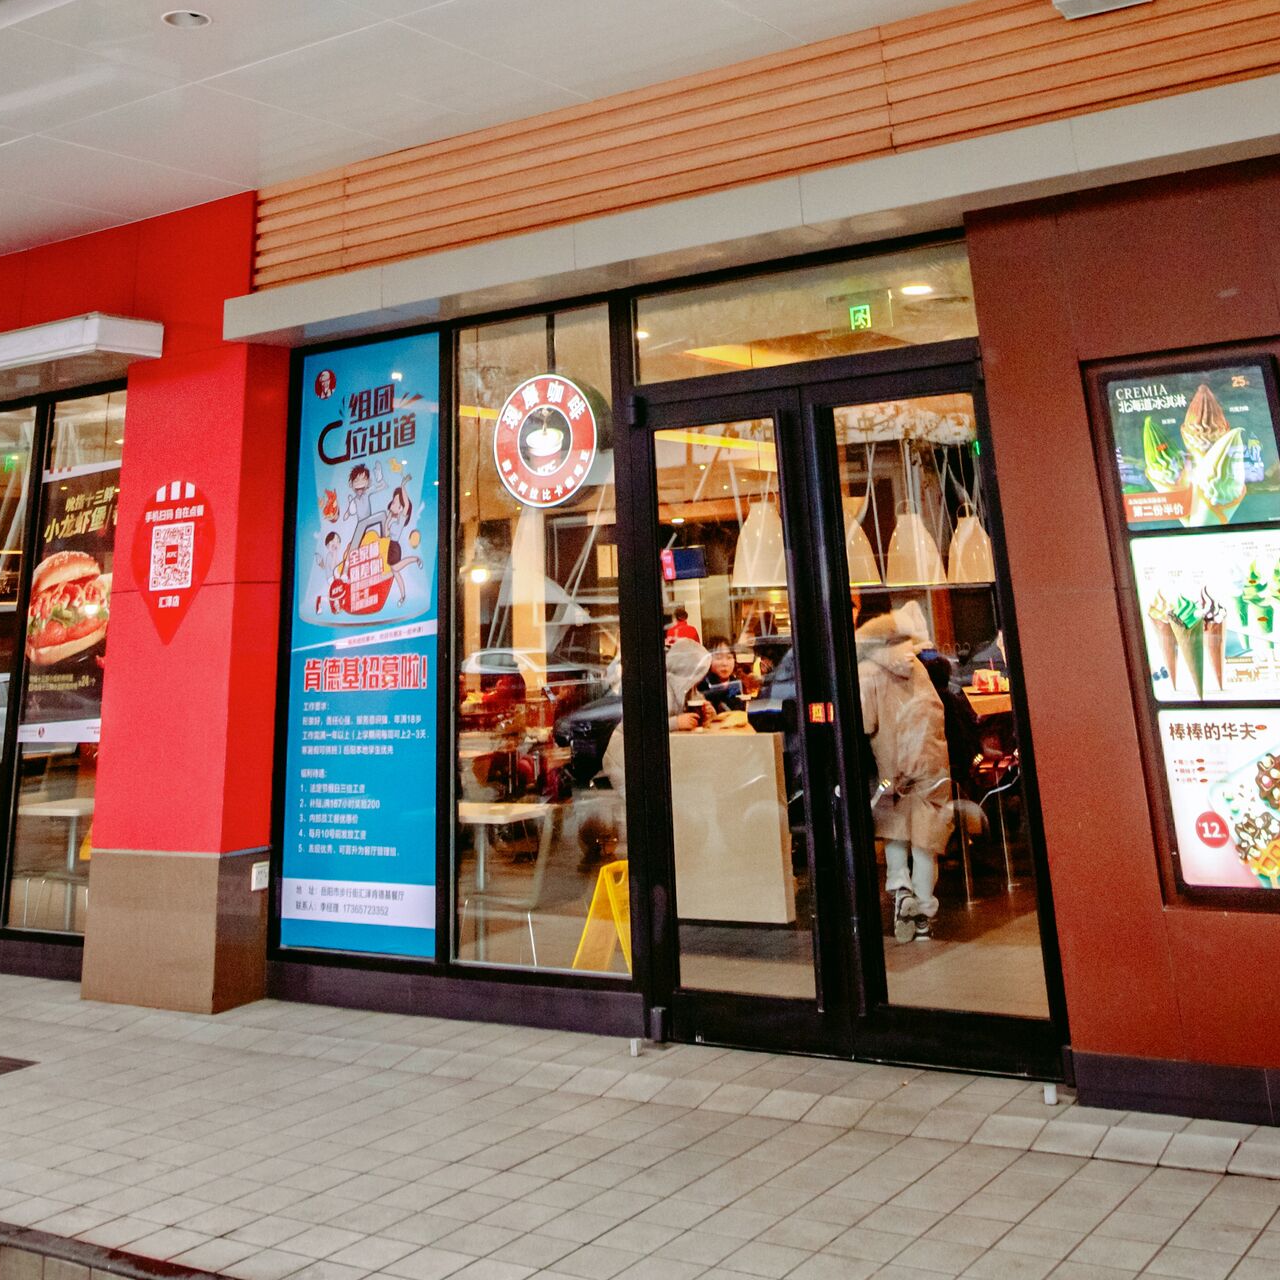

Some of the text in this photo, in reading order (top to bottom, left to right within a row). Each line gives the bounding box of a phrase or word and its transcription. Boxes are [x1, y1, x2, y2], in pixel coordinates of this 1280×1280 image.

[1115, 384, 1169, 401] CREMIA
[349, 384, 395, 425] 组团
[318, 412, 416, 466] C位出道
[145, 504, 205, 523] 手机扫码 自在点餐
[1169, 722, 1258, 741] 棒棒的华夫
